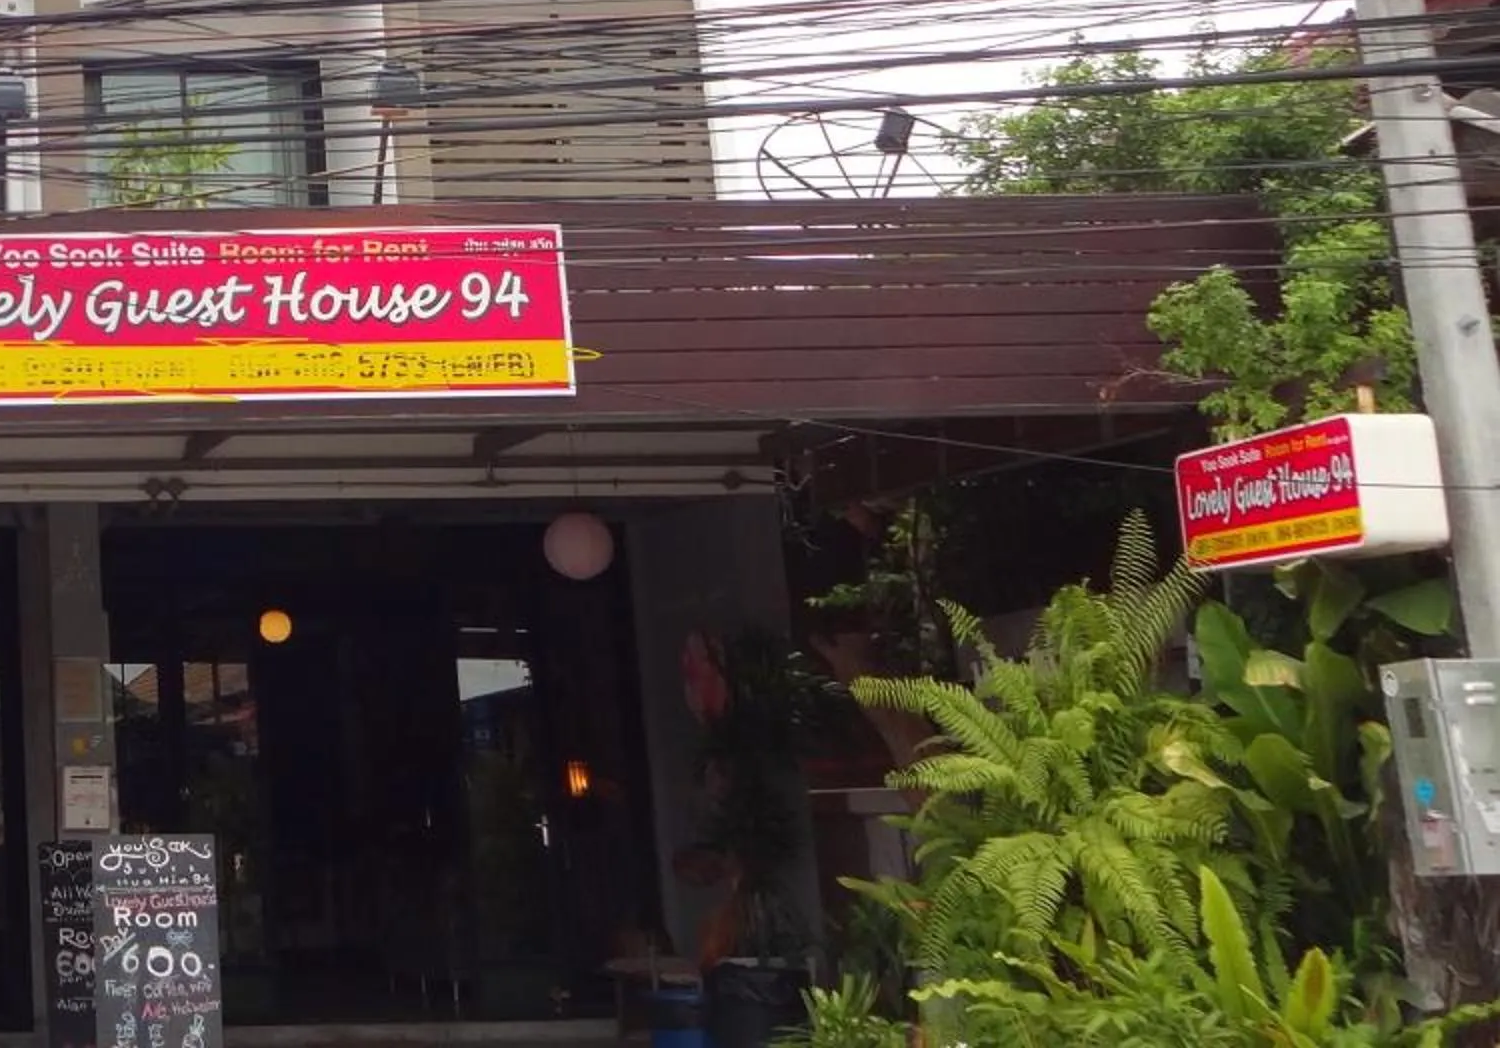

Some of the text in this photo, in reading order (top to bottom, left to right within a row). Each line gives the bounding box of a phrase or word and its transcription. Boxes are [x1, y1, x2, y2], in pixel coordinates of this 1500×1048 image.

[49, 243, 124, 268] Sook
[131, 241, 206, 267] Suite
[219, 240, 304, 265] Room
[313, 239, 355, 264] for
[362, 238, 430, 263] Rent
[85, 275, 253, 333] Guest
[263, 271, 452, 326] House
[461, 270, 530, 319] 94
[1186, 451, 1353, 523] Lovely Guest House 94
[114, 907, 198, 928] Room
[59, 927, 96, 949] Roo
